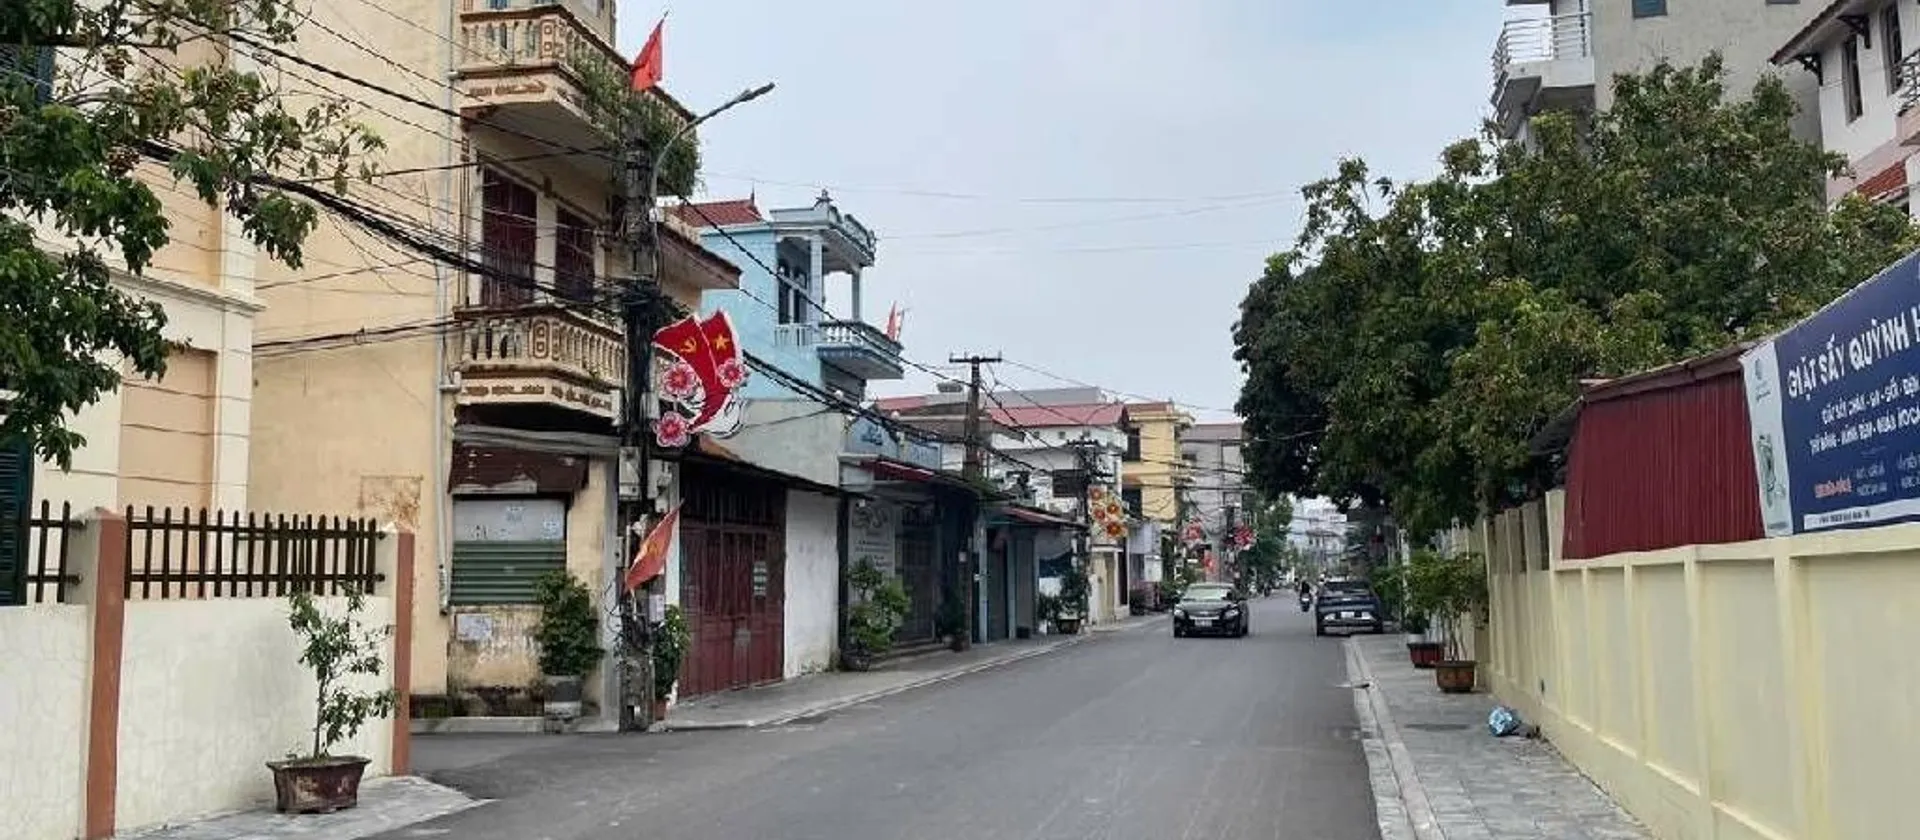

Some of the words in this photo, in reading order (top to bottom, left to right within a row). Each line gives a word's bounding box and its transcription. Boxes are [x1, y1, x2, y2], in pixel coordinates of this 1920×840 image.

[1787, 356, 1817, 401] GIẶT
[1818, 333, 1845, 386] SẤY
[1849, 311, 1909, 370] QUỲNH
